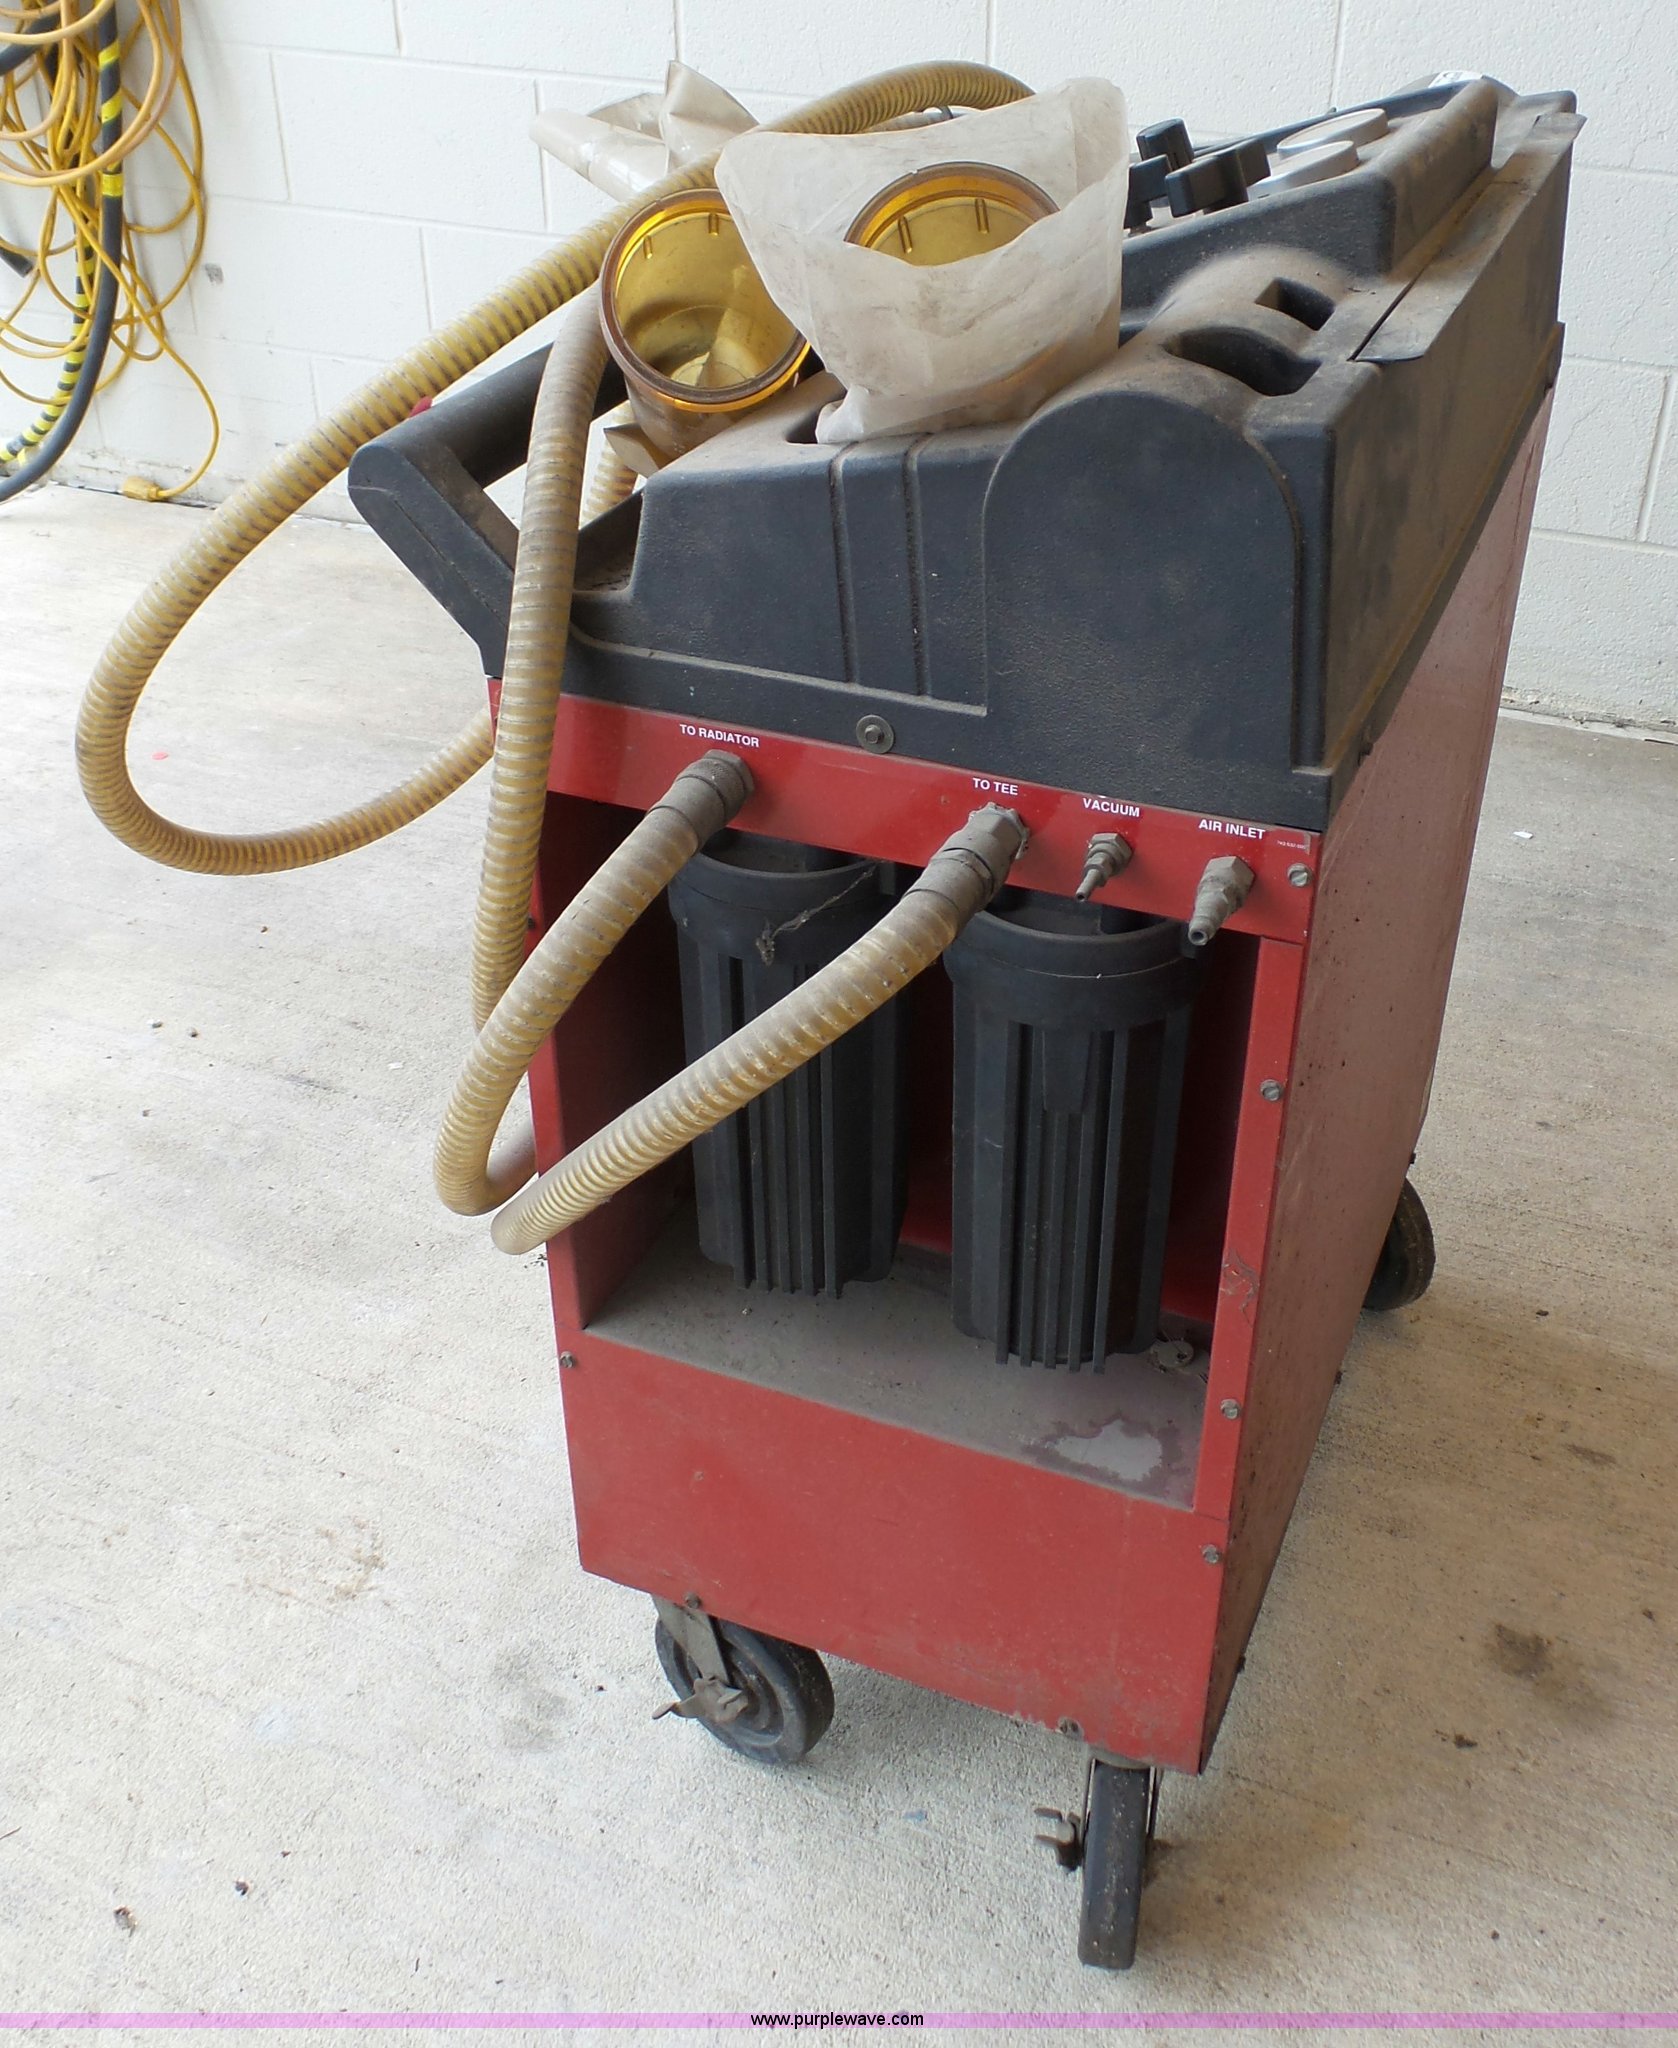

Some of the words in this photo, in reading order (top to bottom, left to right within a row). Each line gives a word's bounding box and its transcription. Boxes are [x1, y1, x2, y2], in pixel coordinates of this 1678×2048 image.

[679, 724, 696, 736] TO
[698, 727, 760, 748] RADIATOR
[972, 777, 991, 790] TO
[993, 781, 1019, 796] TEE
[1083, 797, 1140, 818] VACUUM
[1198, 818, 1222, 833] AIR
[1225, 822, 1266, 840] INLET
